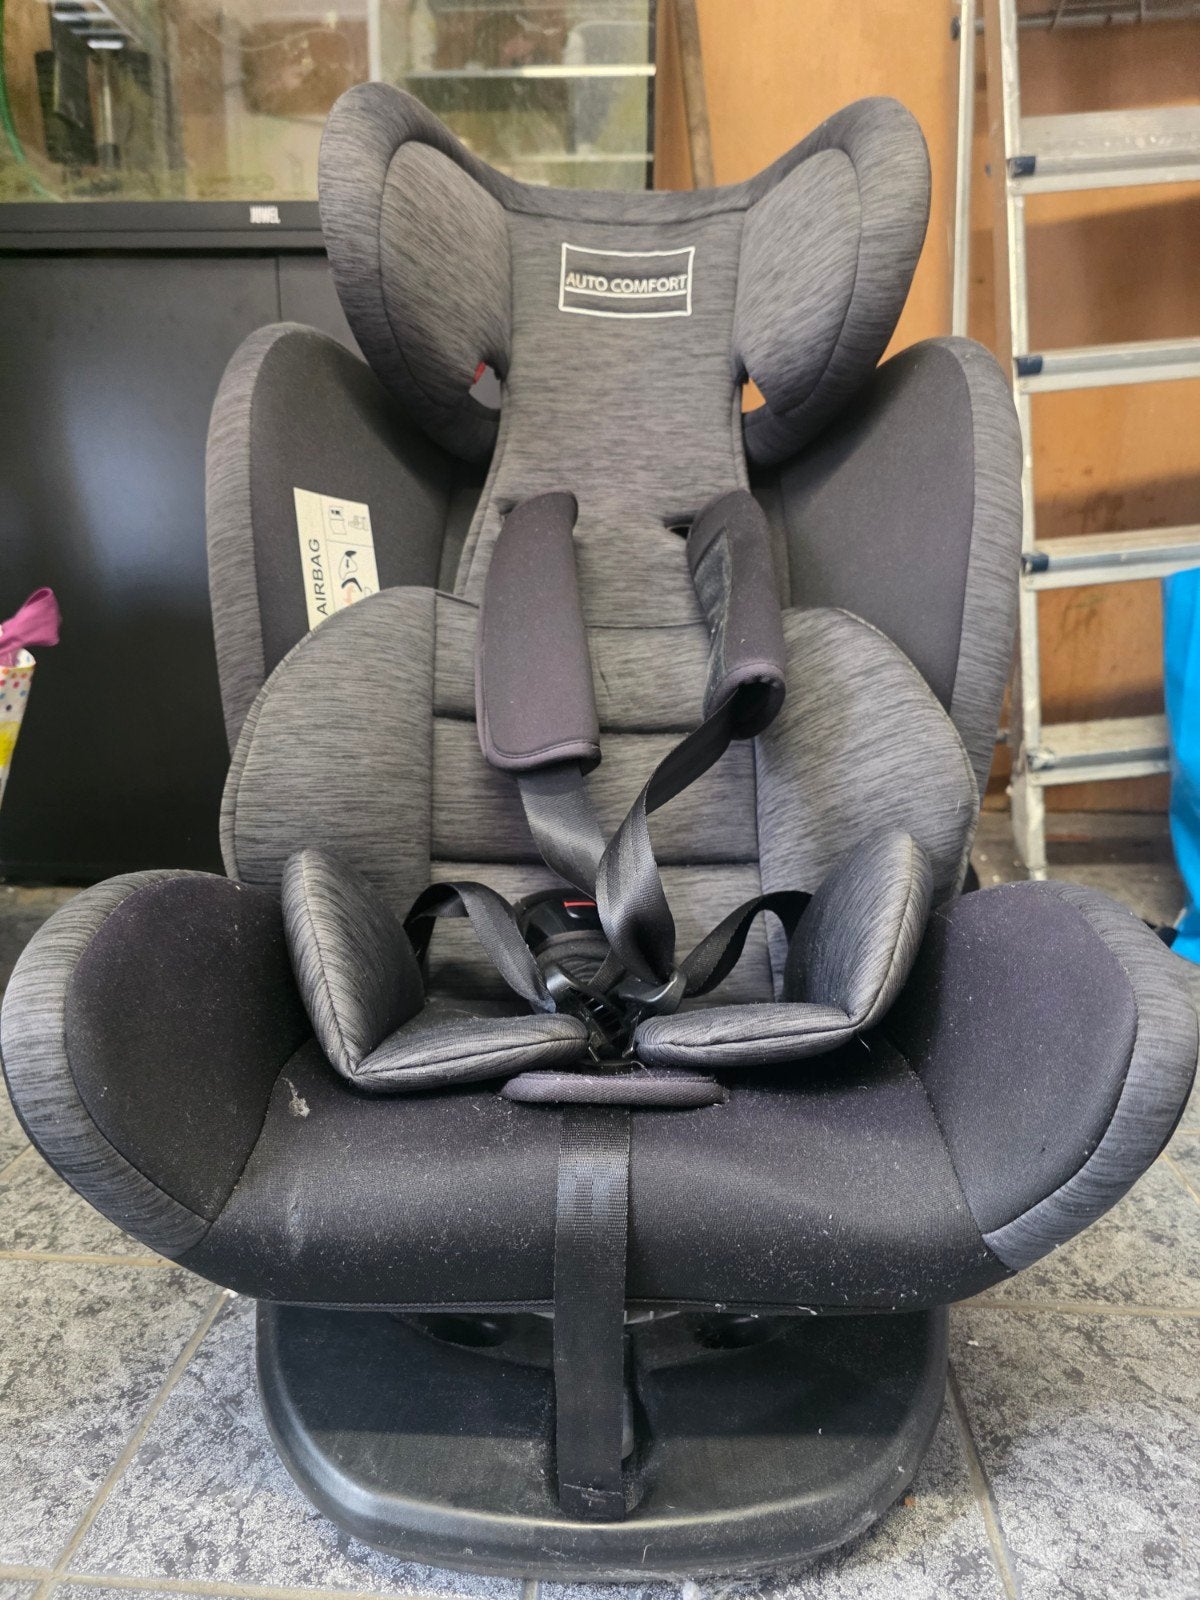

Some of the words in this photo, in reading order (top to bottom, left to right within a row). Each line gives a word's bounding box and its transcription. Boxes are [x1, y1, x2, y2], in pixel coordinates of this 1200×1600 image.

[566, 272, 608, 291] AUTO
[610, 274, 688, 293] COMFORT
[308, 539, 328, 616] AIRBAG
